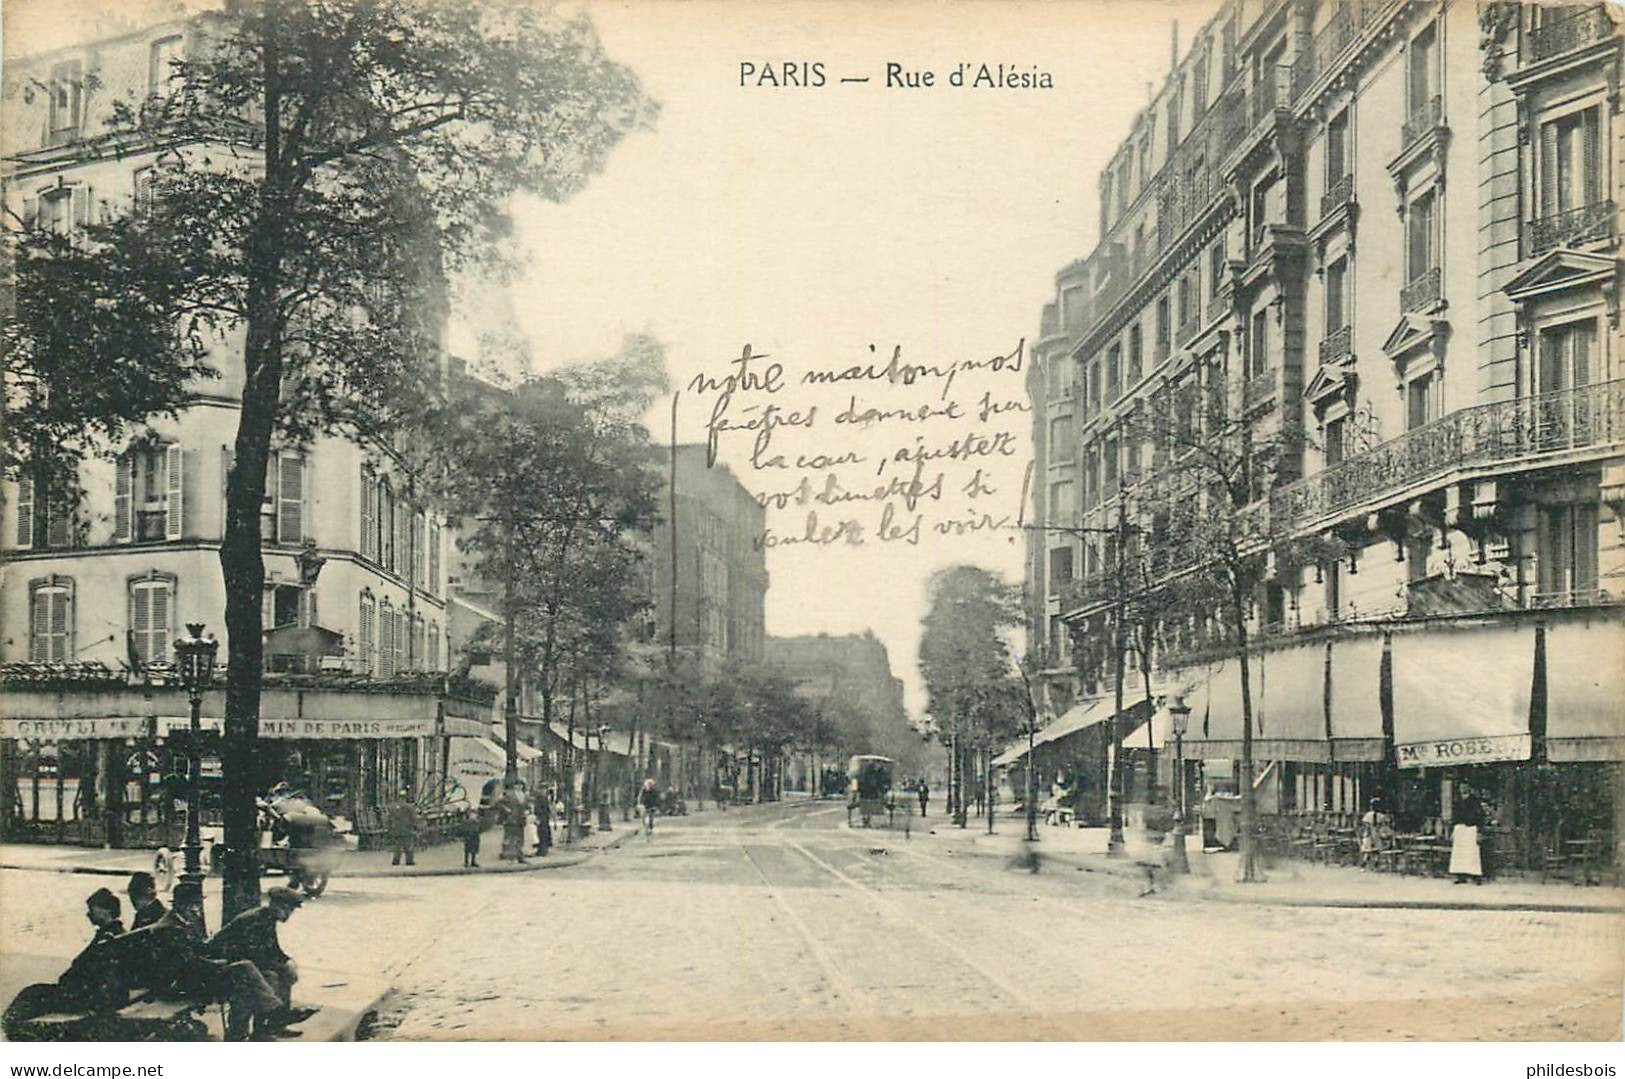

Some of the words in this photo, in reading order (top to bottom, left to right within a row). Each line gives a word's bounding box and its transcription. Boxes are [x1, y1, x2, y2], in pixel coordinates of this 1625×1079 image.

[687, 343, 785, 394] notre
[835, 395, 966, 430] donnent
[978, 391, 1033, 423] sur
[894, 432, 1017, 490] ajustez
[962, 468, 998, 499] si
[876, 502, 924, 545] les
[303, 722, 324, 734] DE
[331, 722, 381, 734] PARIS
